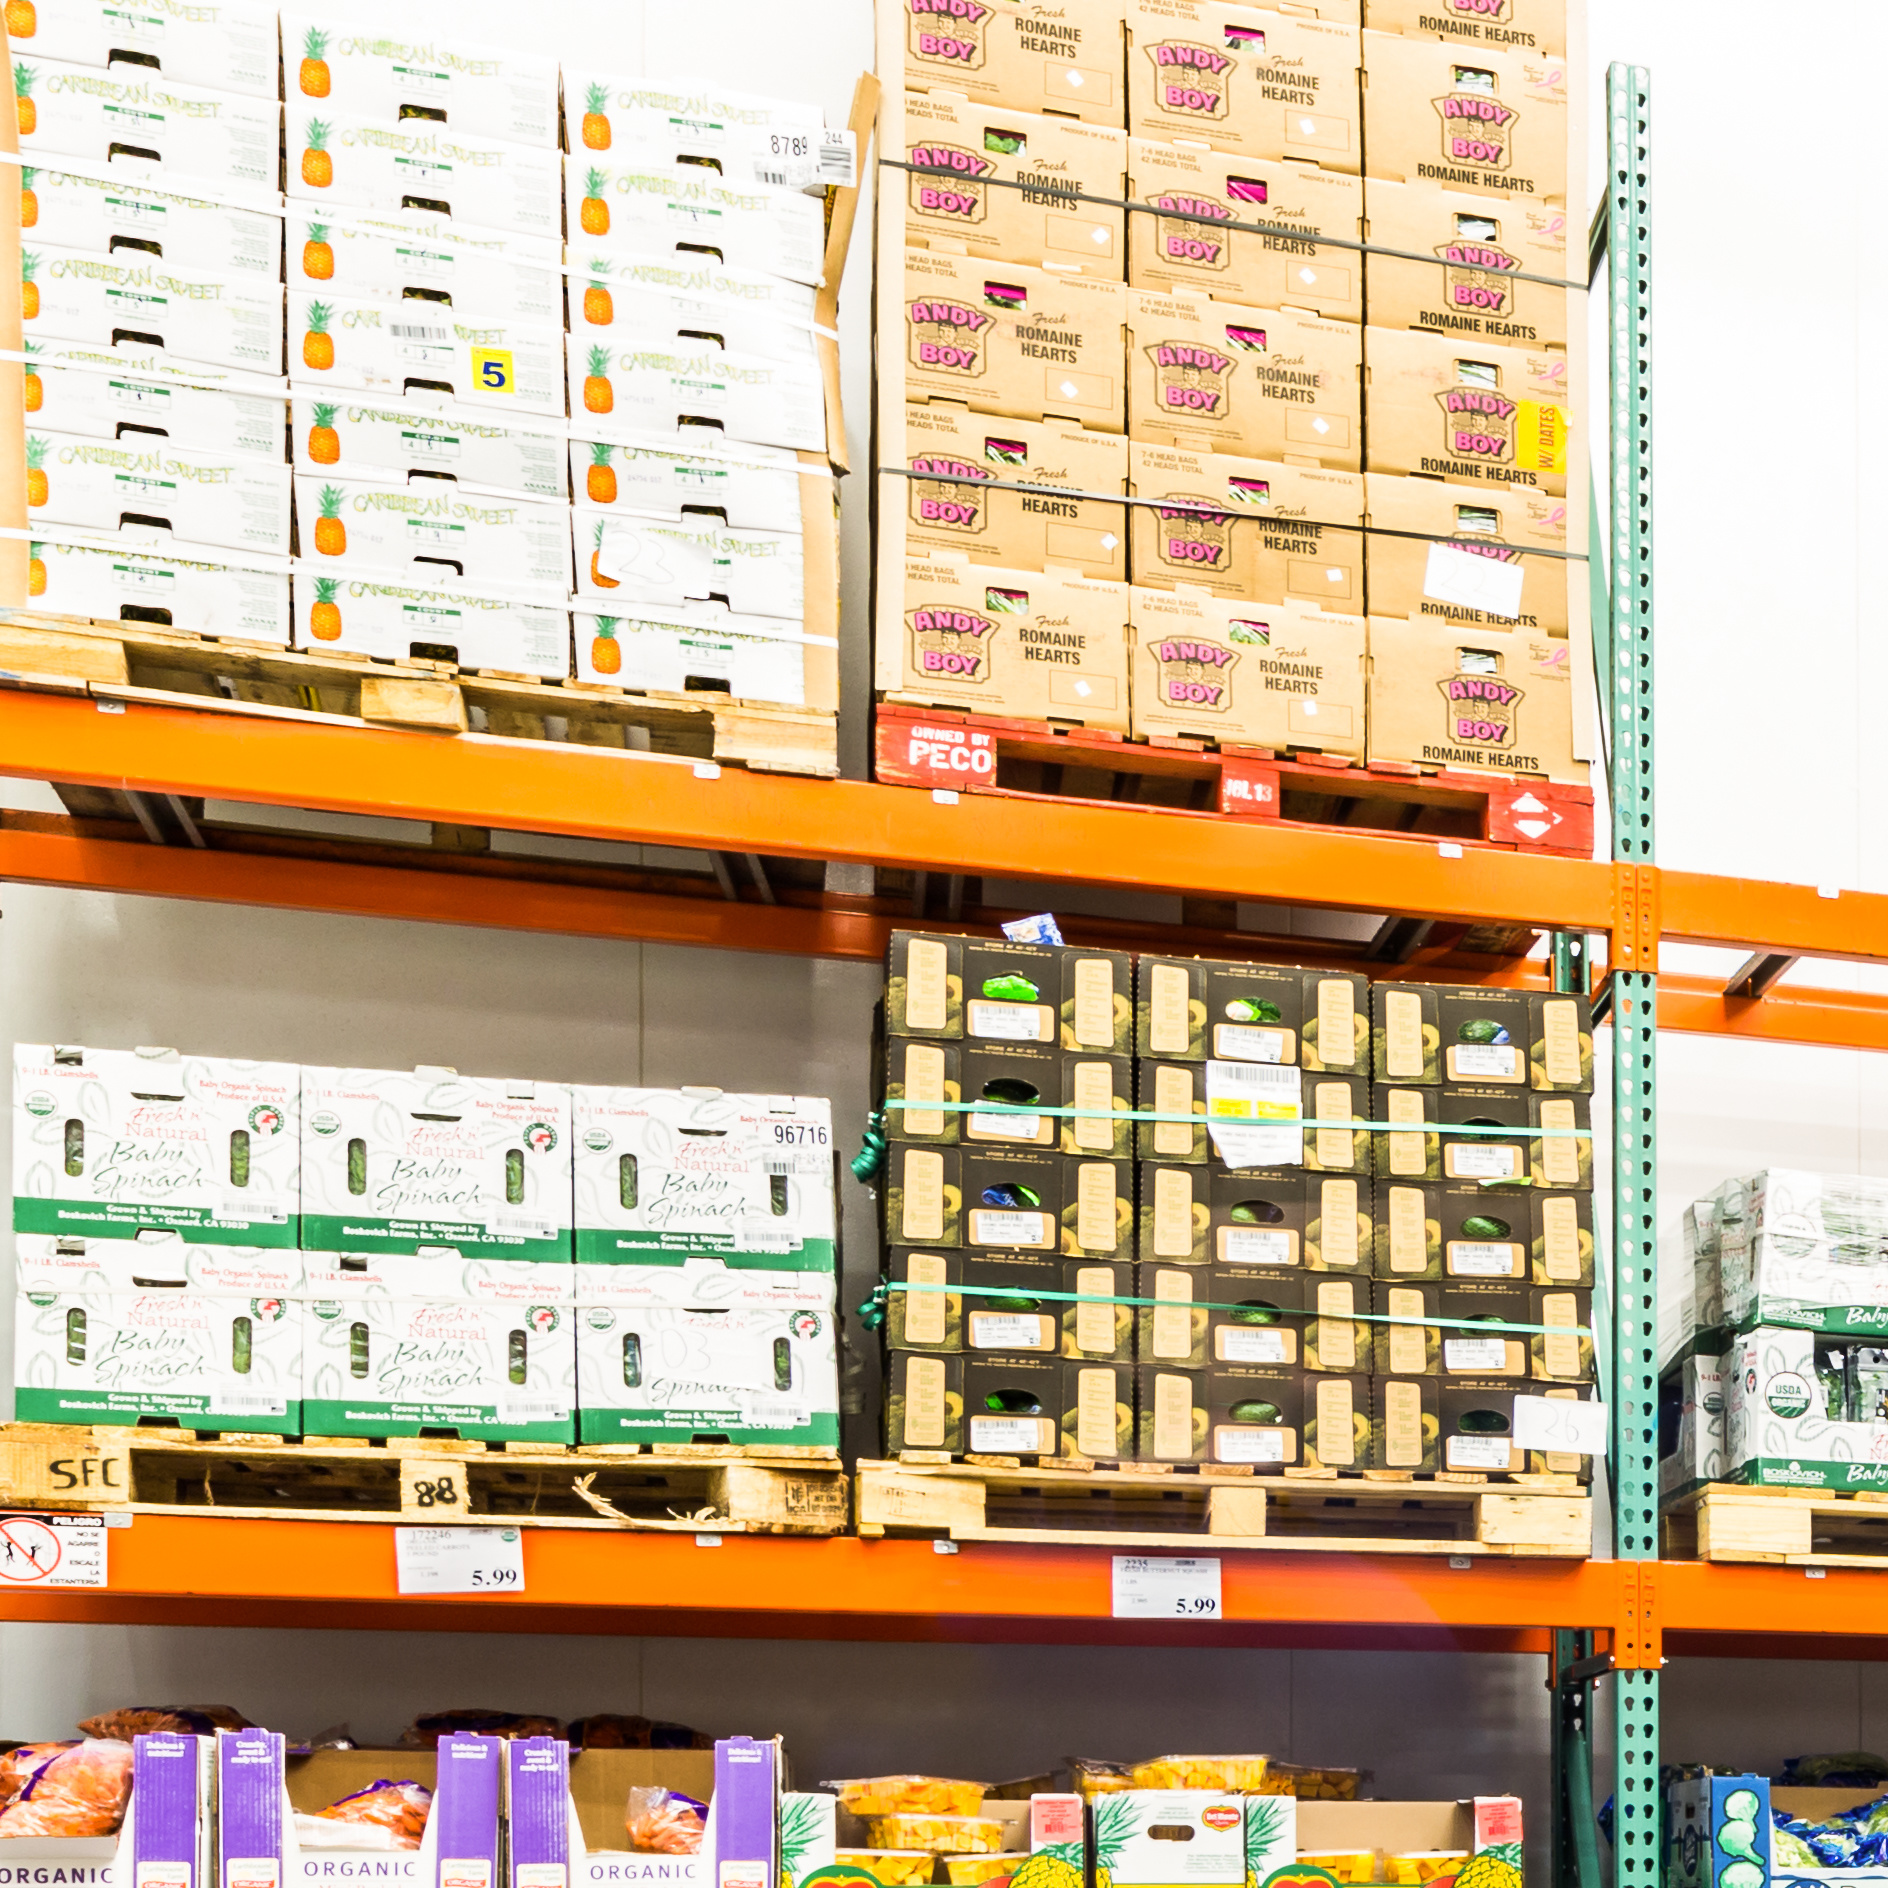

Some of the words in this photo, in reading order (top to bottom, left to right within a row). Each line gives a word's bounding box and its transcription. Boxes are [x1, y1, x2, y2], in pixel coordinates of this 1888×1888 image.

[1444, 98, 1514, 128] ANDY
[1451, 138, 1499, 164] BOY
[1418, 164, 1480, 188] ROMAINE
[1484, 172, 1534, 192] HEARTS
[482, 361, 506, 387] 5
[1540, 405, 1556, 444] DATES
[915, 612, 991, 638] ANDY
[925, 651, 980, 676] BOY
[1275, 647, 1307, 658] Fresh
[1260, 660, 1323, 680] ROMAINE
[1265, 676, 1318, 695] HEARTS
[911, 726, 965, 743] OWNED
[972, 734, 990, 746] BY
[909, 740, 992, 773] PECO
[199, 1080, 219, 1090] Baby
[221, 1081, 252, 1093] Organic
[254, 1084, 286, 1094] Spinach
[124, 1124, 207, 1142] Natural
[773, 1123, 828, 1147] 96716
[109, 1141, 186, 1167] Baby
[93, 1168, 204, 1195] Spinach
[1777, 1386, 1801, 1396] USDA
[50, 1458, 121, 1491] SFC
[472, 1569, 517, 1586] 5.99
[1176, 1598, 1216, 1613] 5.99
[304, 1861, 416, 1878] ORGANIC
